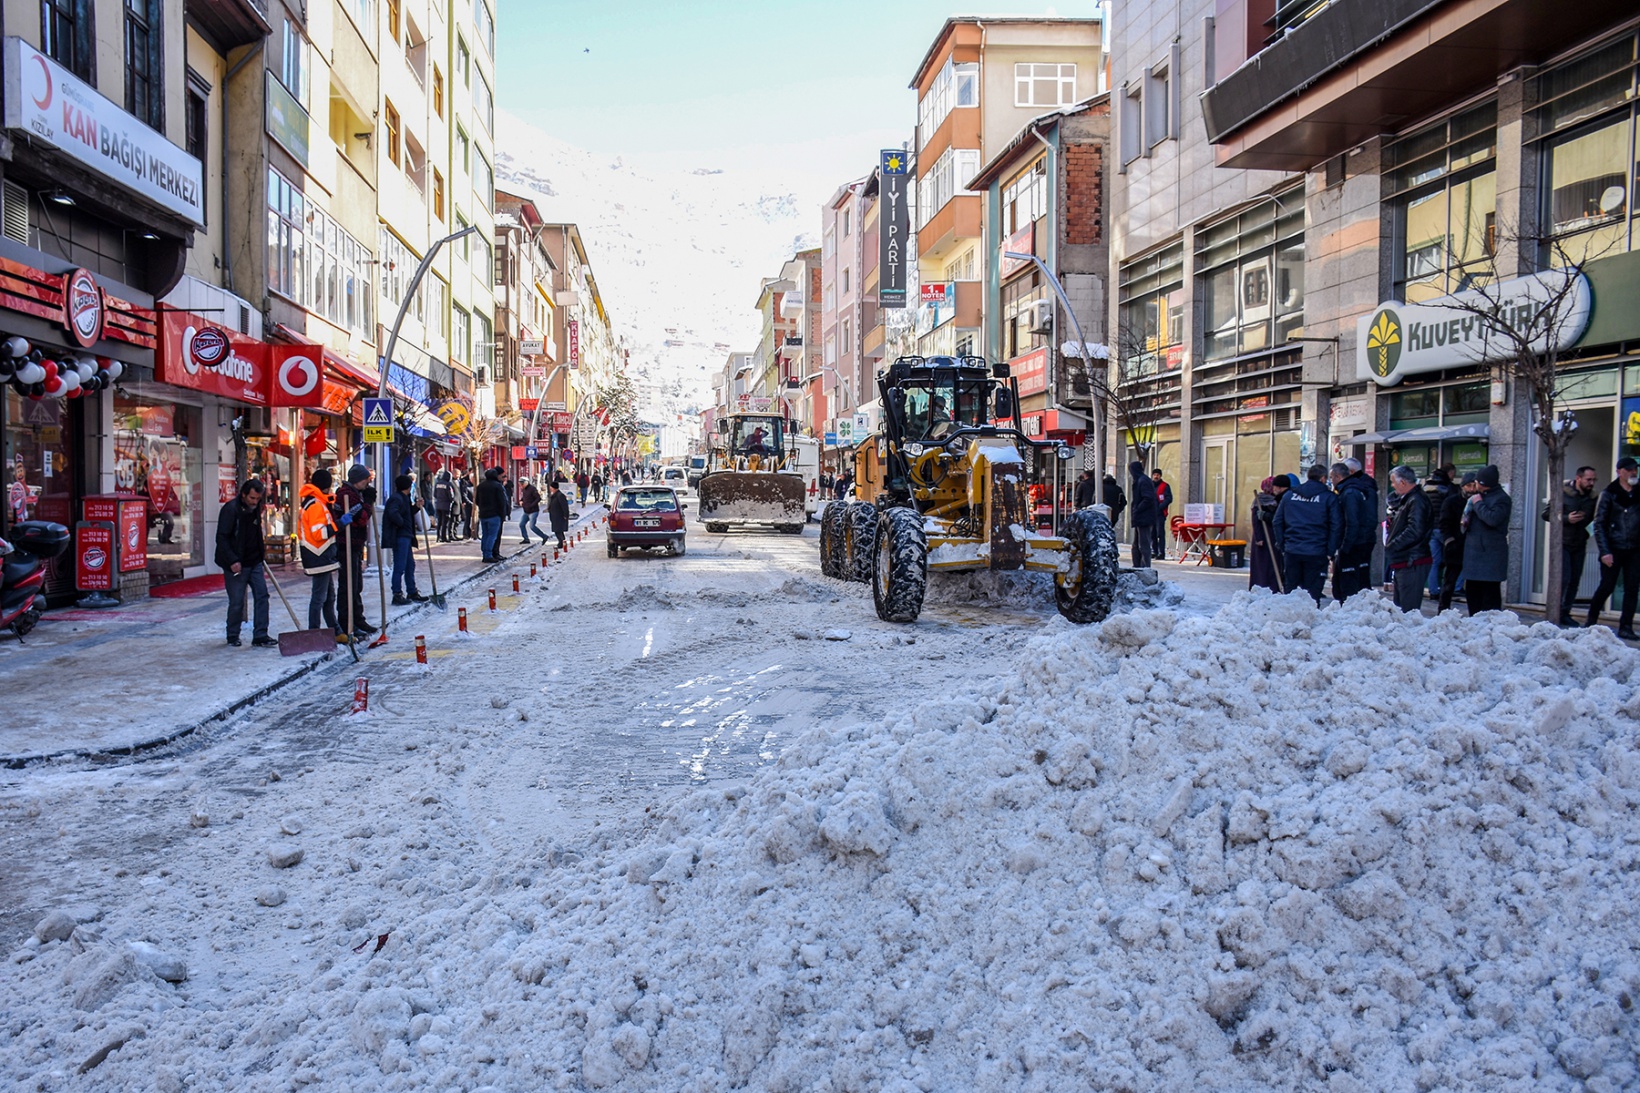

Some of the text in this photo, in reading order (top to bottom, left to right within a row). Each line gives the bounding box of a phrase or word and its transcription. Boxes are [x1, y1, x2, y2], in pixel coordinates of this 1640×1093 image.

[31, 118, 55, 140] KIZILAY
[62, 99, 199, 208] KAN BAĞIŞI MERKEZİ
